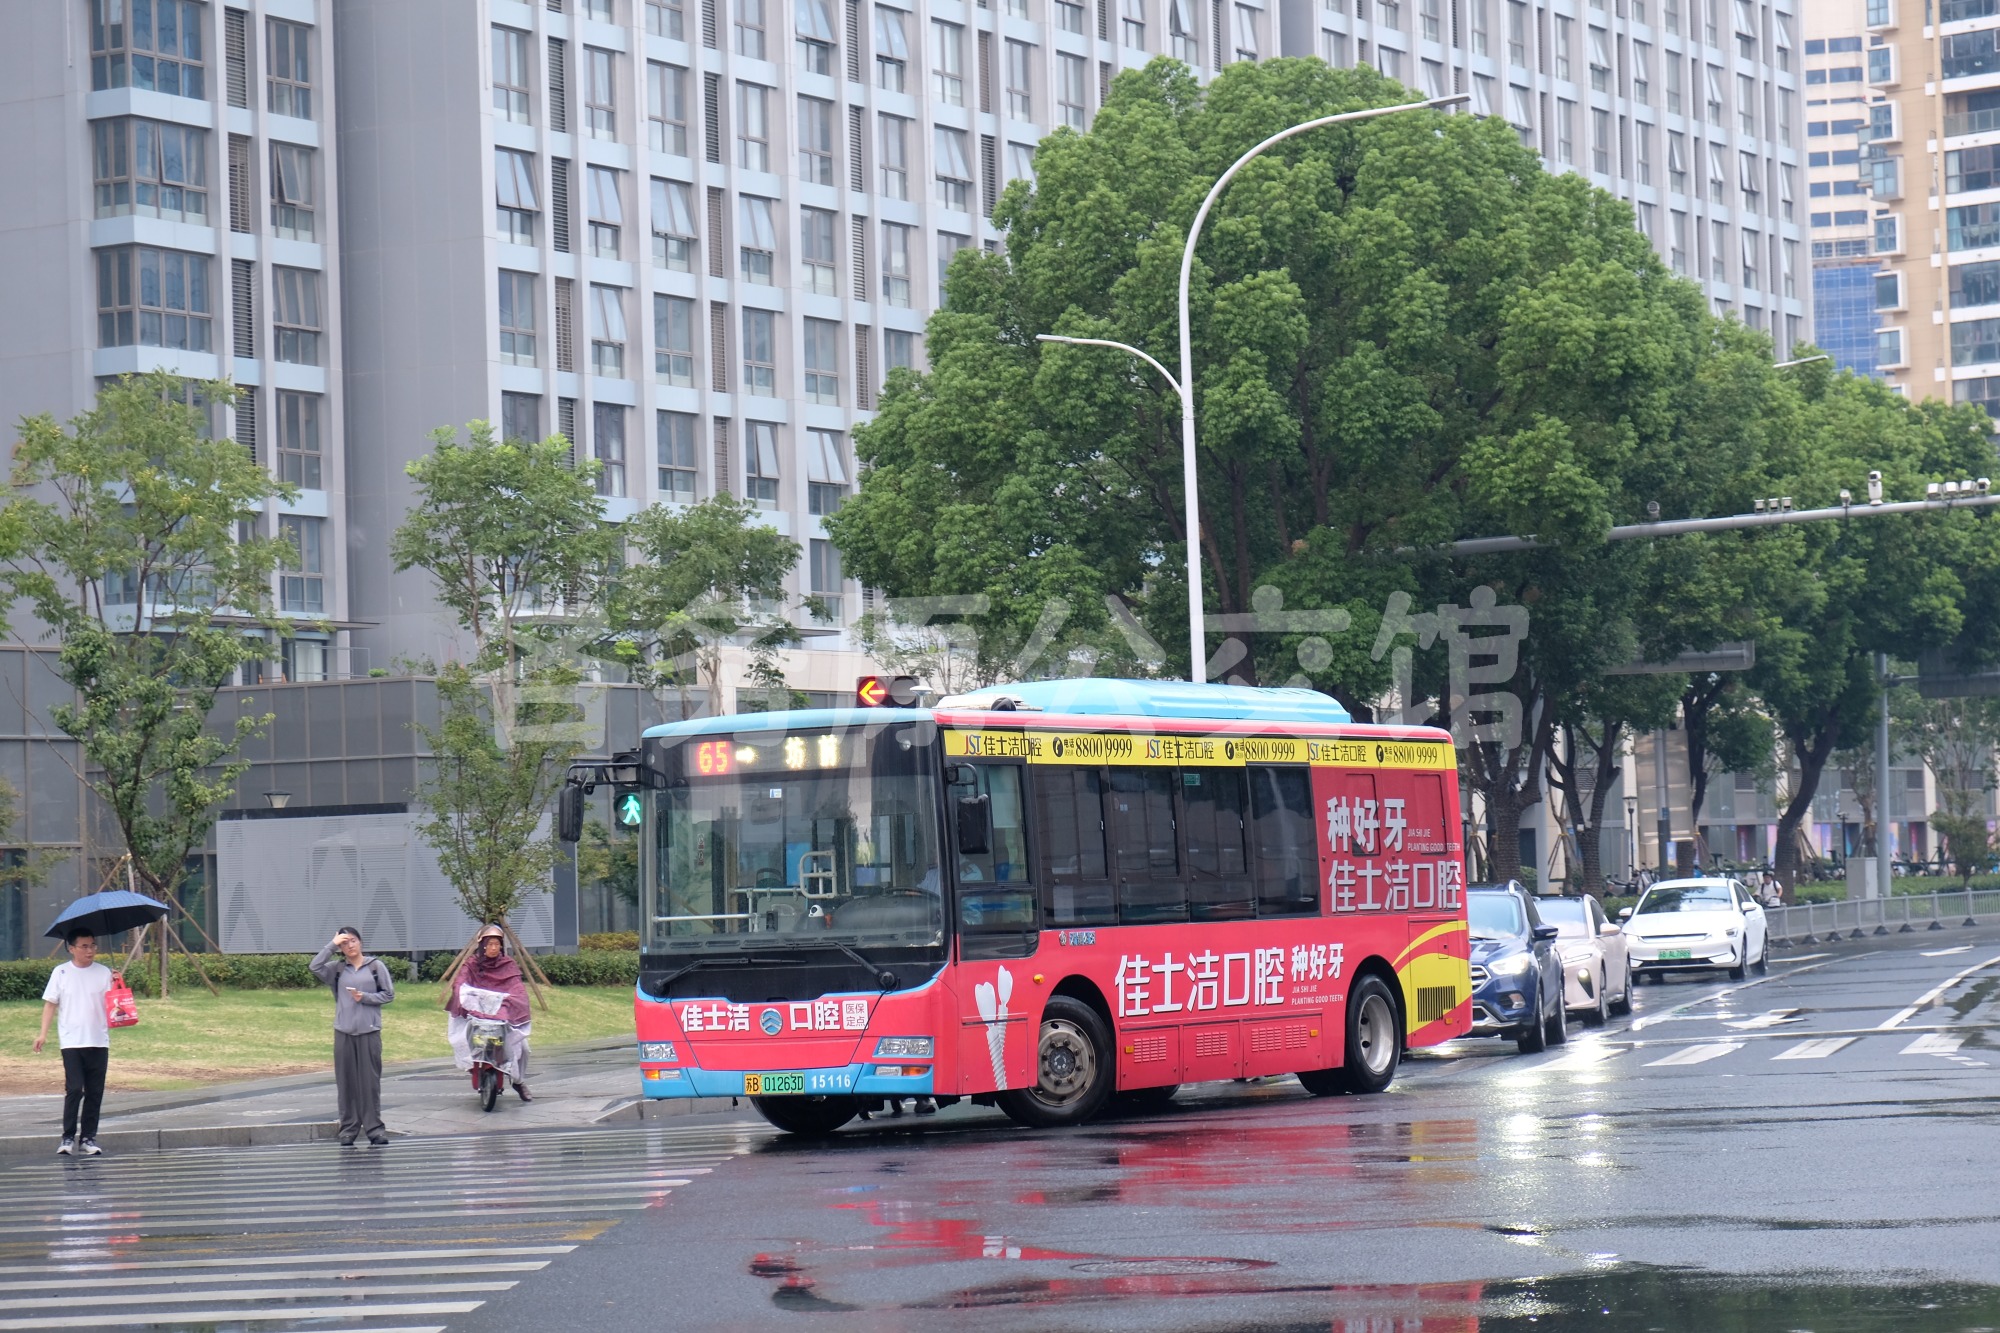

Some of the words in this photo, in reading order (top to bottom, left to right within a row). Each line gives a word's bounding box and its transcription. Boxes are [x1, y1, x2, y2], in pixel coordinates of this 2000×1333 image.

[963, 734, 983, 756] JST
[984, 736, 1043, 757] 佳士洁口腔
[1075, 737, 1103, 758] 8800
[1105, 738, 1133, 758] 9999
[1145, 739, 1162, 759] JST
[1163, 740, 1214, 760] 佳士洁口腔
[1245, 741, 1269, 760] 8800
[1271, 742, 1295, 761] 9999
[1321, 744, 1367, 762] 佳士洁口腔
[1393, 745, 1415, 763] 8800
[1416, 746, 1438, 764] 9999
[699, 742, 728, 773] 65
[1327, 796, 1407, 852] 种好牙
[1328, 860, 1462, 913] 佳士洁口腔
[1114, 947, 1285, 1018] 佳士洁口腔
[1291, 943, 1344, 982] 种好牙
[845, 1003, 865, 1014] 医保
[1291, 997, 1314, 1005] PLANTING
[1315, 995, 1328, 1003] GOOD
[1329, 994, 1343, 1002] TEETH
[680, 1003, 750, 1032] 佳士洁
[789, 1000, 841, 1031] 口腔
[846, 1016, 867, 1027] 定点
[764, 1076, 804, 1092] 01263D
[811, 1074, 851, 1089] 15116
